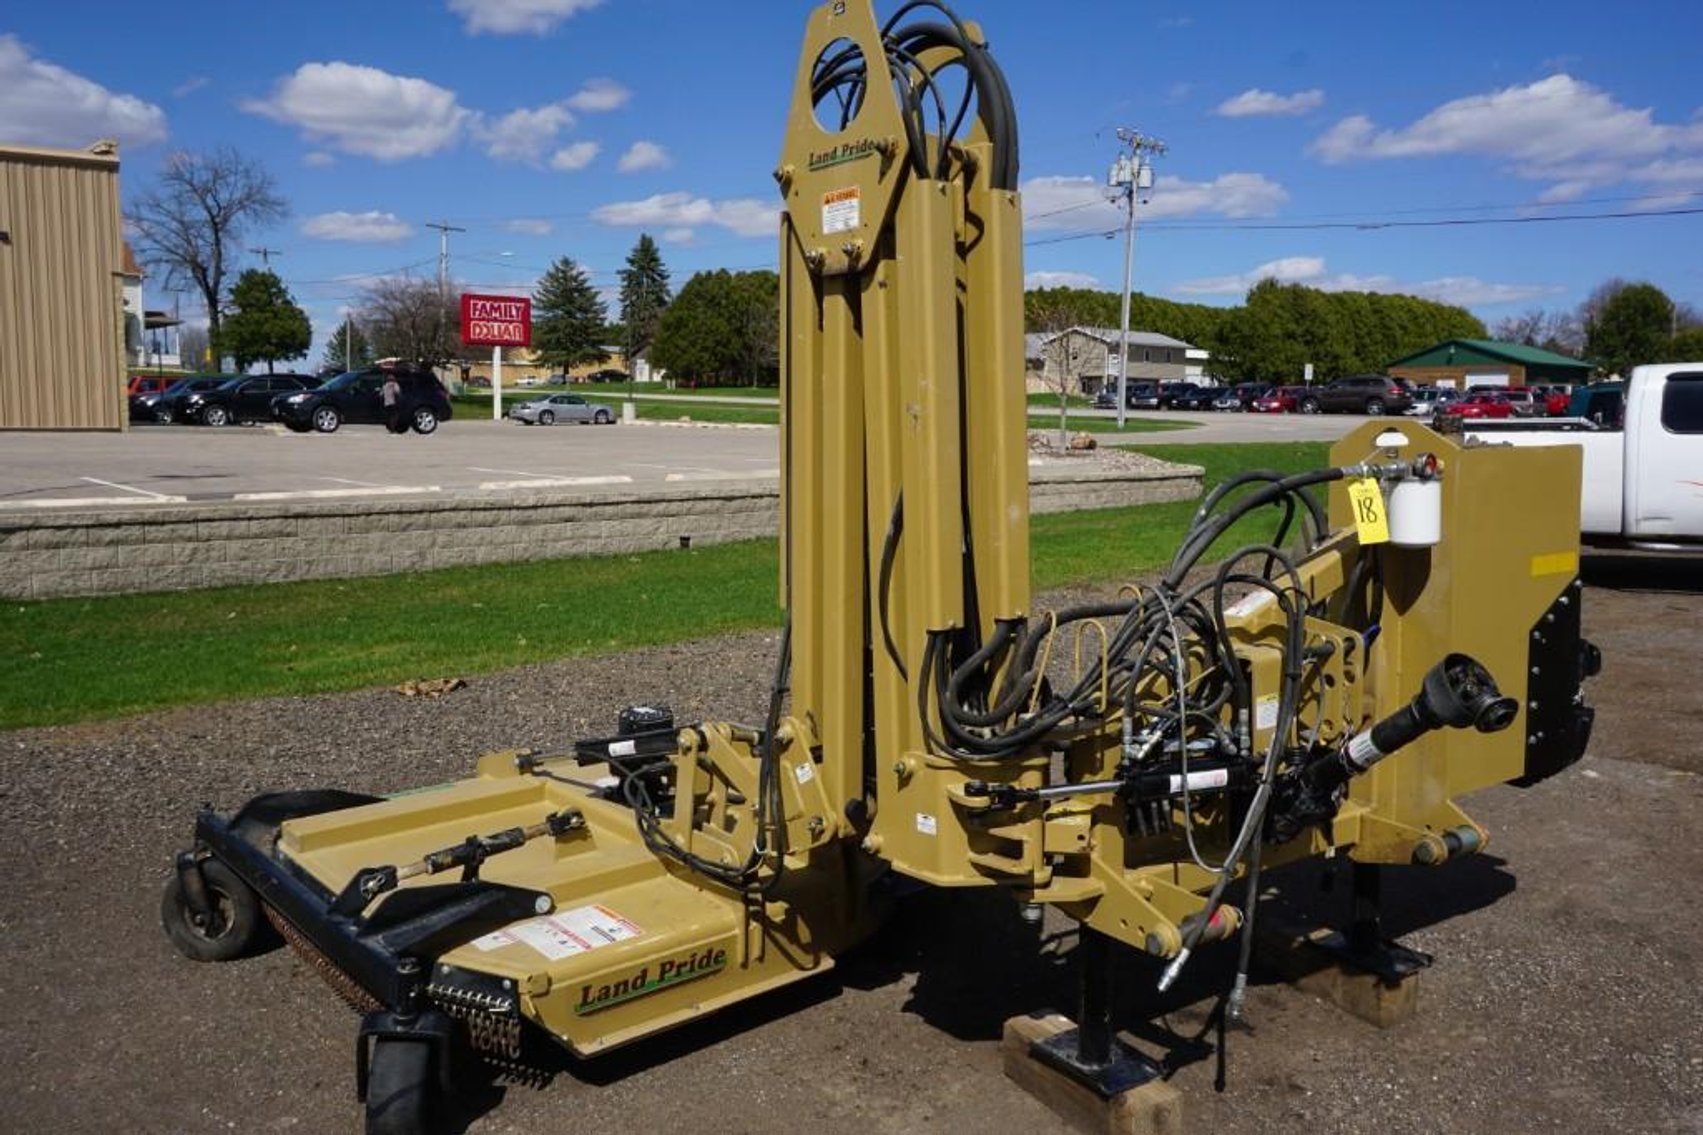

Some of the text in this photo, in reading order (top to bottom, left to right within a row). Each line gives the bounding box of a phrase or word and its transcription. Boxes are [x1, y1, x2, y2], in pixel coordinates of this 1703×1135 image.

[808, 138, 875, 166] Land Pride
[471, 300, 524, 320] FAMILY
[471, 321, 523, 341] DOLLAR
[1357, 497, 1377, 523] 18
[579, 947, 726, 1006] Land Pride
